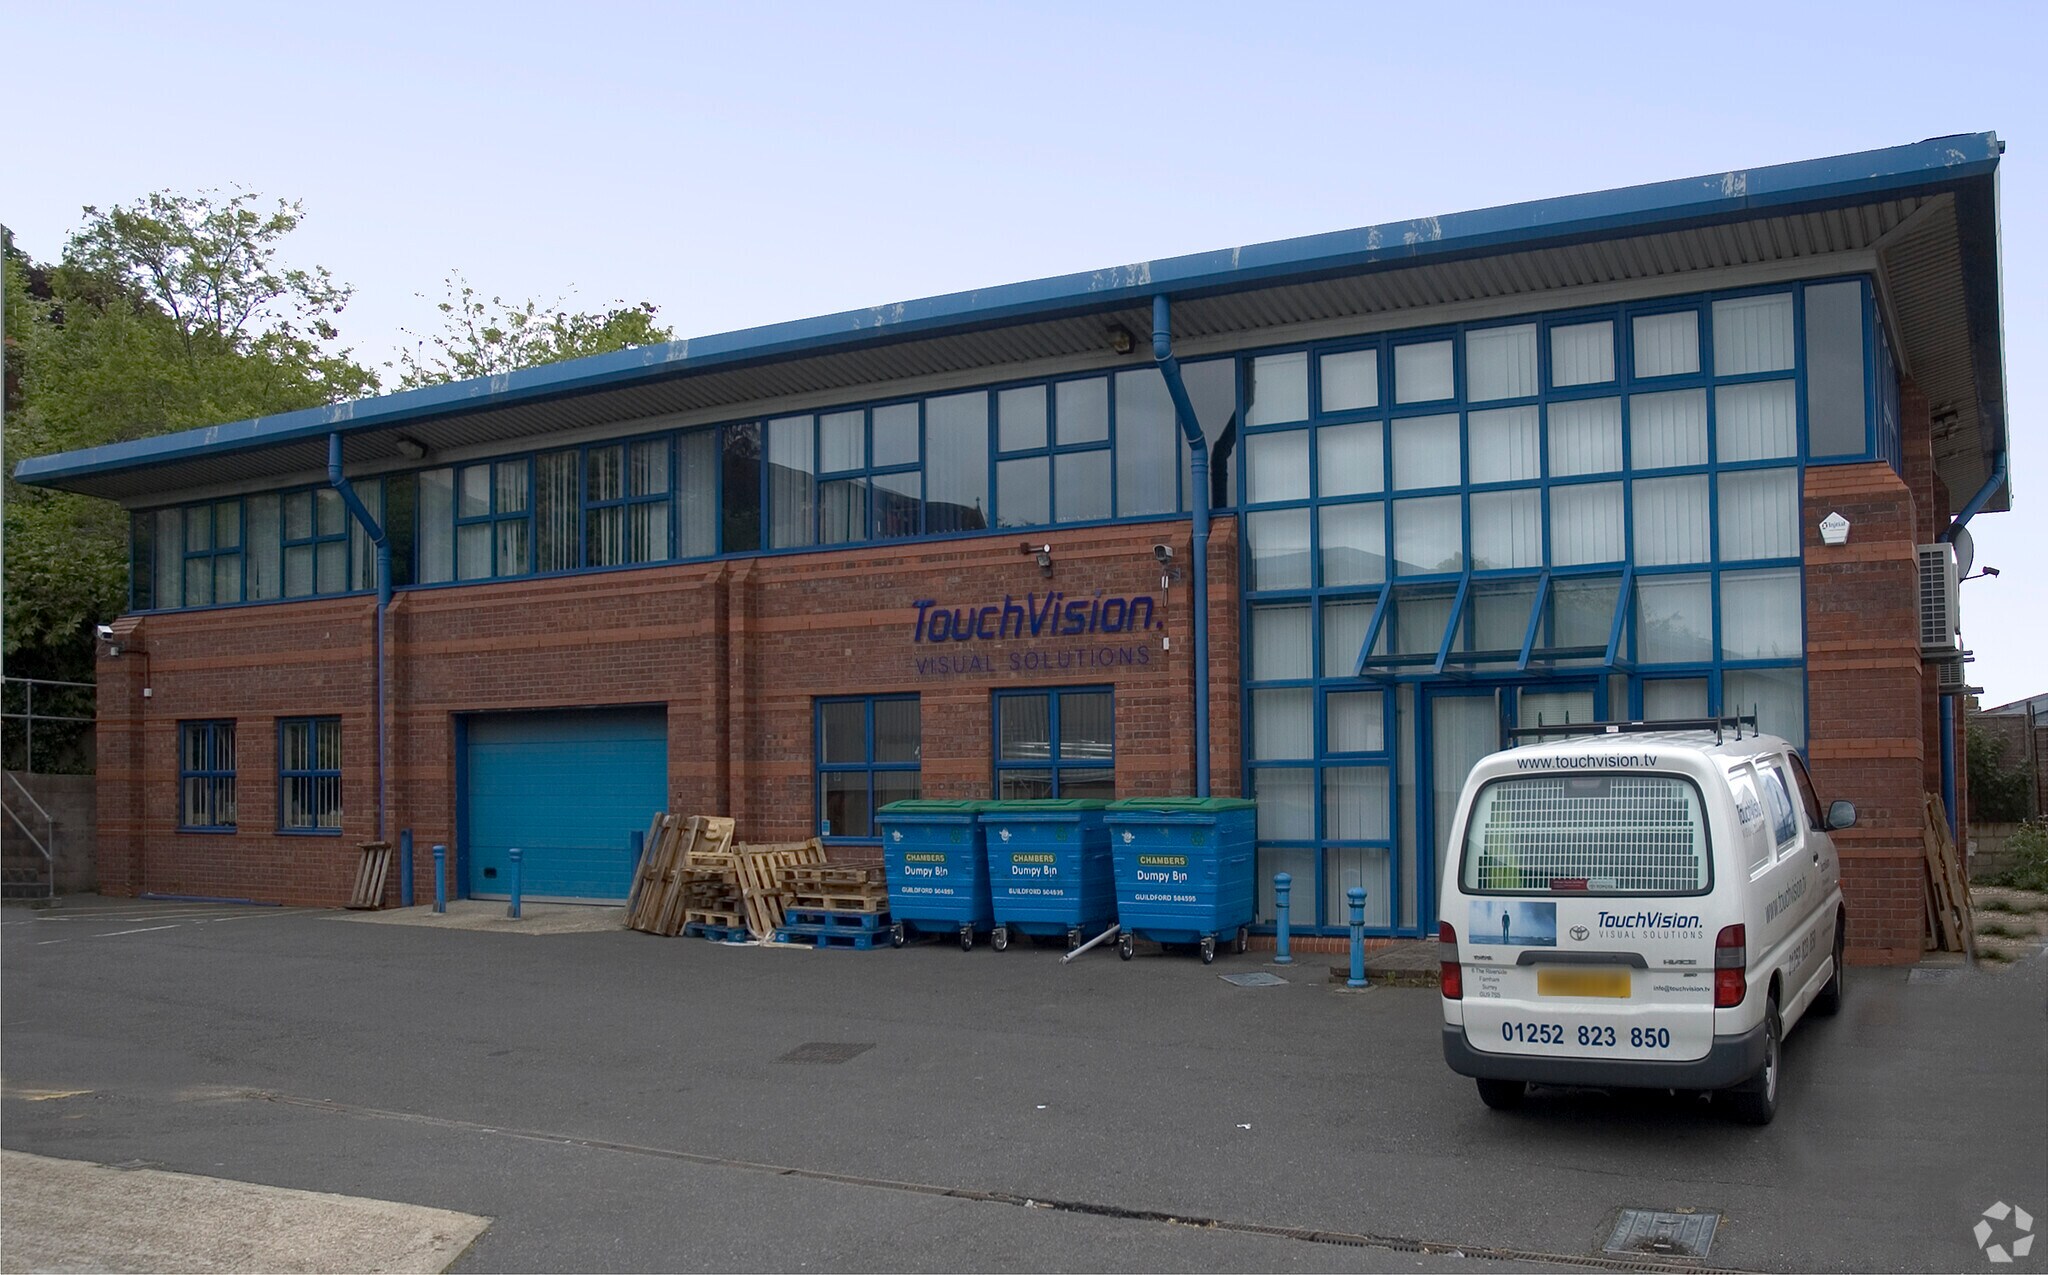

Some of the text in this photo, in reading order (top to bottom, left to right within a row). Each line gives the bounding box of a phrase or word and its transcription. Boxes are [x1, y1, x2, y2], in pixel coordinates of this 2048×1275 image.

[916, 645, 1150, 675] VISUAL SOLUTIONS
[1516, 752, 1657, 769] www.touchvision.tv
[906, 854, 945, 862] CHAMBERS
[1013, 854, 1054, 863] CHAMBERS
[1140, 856, 1185, 865] CHAMBERS
[904, 865, 933, 878] Dumpy
[1011, 865, 1041, 878] Dumpy
[1137, 870, 1170, 883] Dumpy
[901, 886, 933, 894] GUILDFORD
[1599, 930, 1703, 940] VISUAL SOLUTIONS
[1653, 985, 1711, 993] info@touchvision.tv
[1502, 1021, 1671, 1049] 01252 823 850
